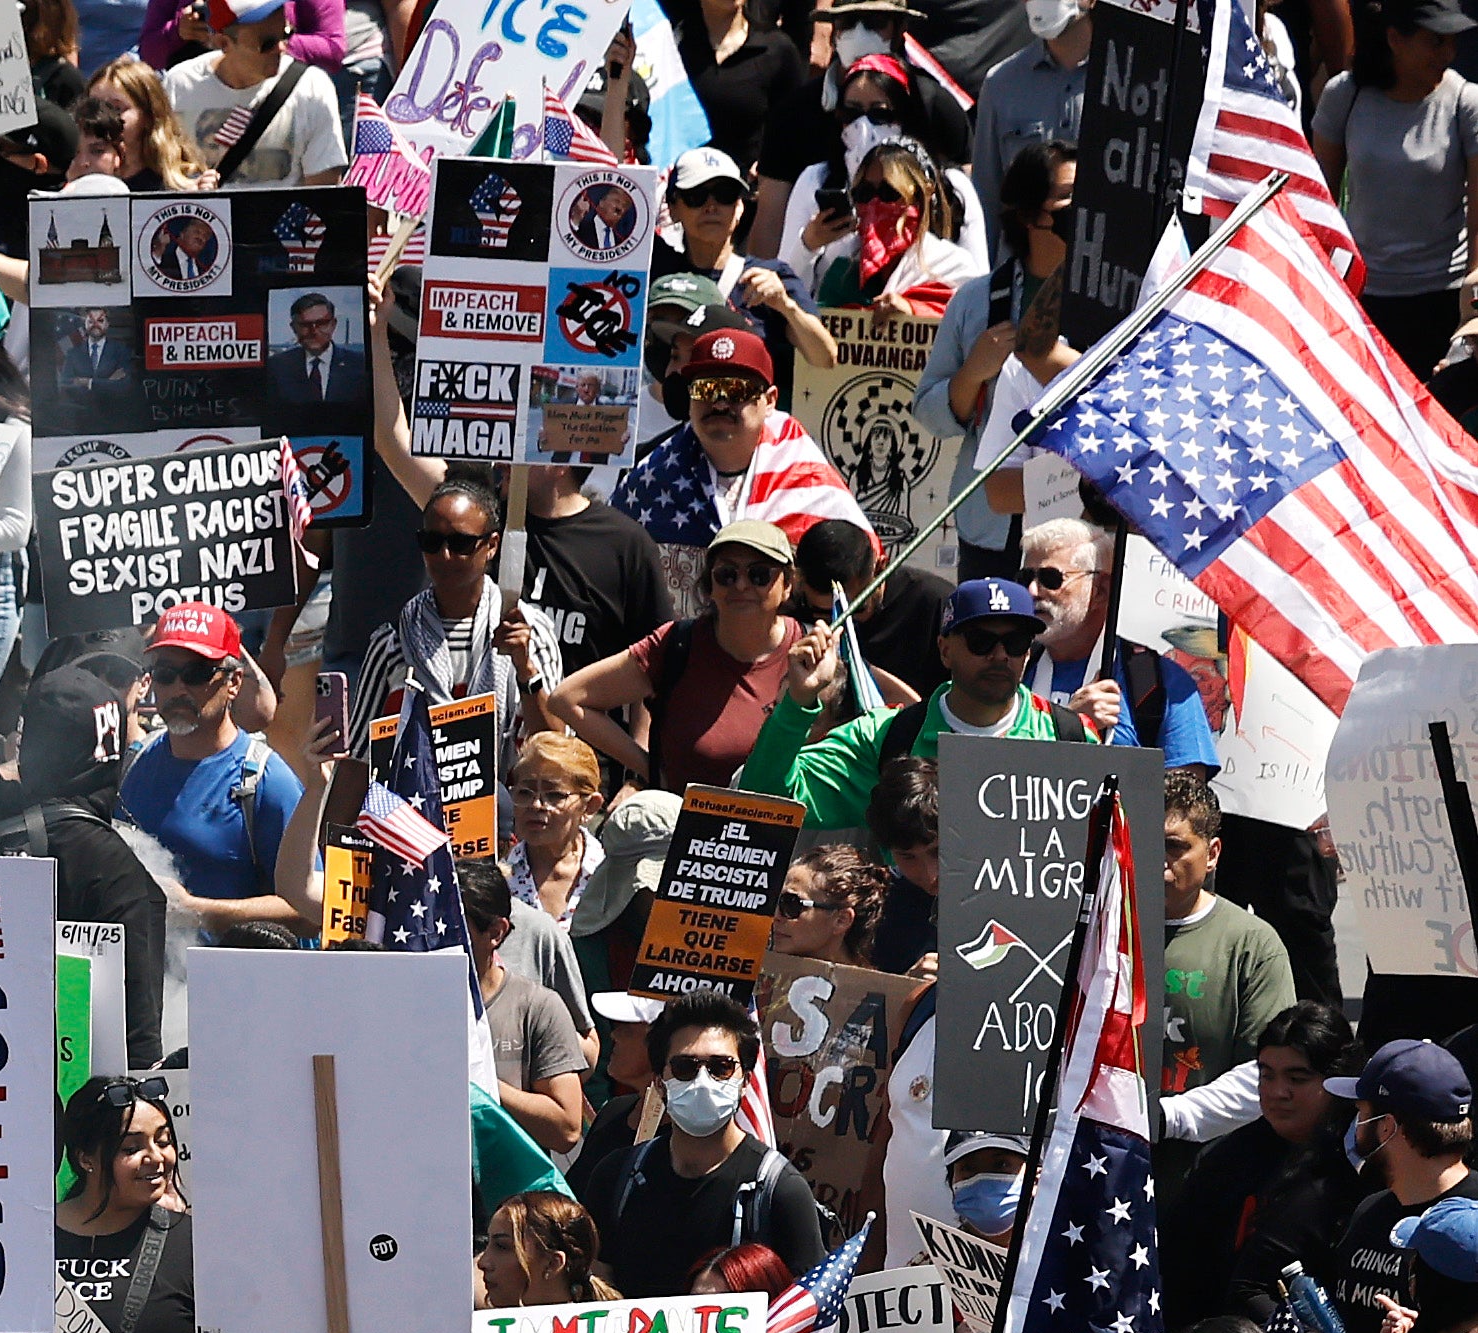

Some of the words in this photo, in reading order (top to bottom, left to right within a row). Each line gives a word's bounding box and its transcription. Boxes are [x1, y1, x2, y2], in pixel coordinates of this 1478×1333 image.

[431, 291, 517, 312] IMPEACH
[444, 314, 460, 333] &
[466, 314, 538, 334] REMOVE
[52, 465, 152, 512] SUPER
[162, 449, 280, 496] CALLOUS
[62, 512, 181, 556] FRAGILE
[189, 496, 283, 539] RACIST
[68, 555, 187, 595] SEXIST
[201, 543, 275, 580] NAZI
[133, 582, 245, 619] POTUS
[689, 795, 796, 825] RefuseFascism.org
[719, 821, 751, 841] ¡EL
[687, 837, 777, 868] RÉGIMEN
[675, 860, 770, 888] FASCISTA
[669, 882, 701, 901] DE
[702, 884, 767, 909] TRUMP
[679, 907, 740, 934] TIENE
[684, 930, 726, 952] QUE
[644, 942, 753, 975] LARGARSE
[648, 973, 733, 997] AHORA!
[372, 1238, 396, 1258] FDT
